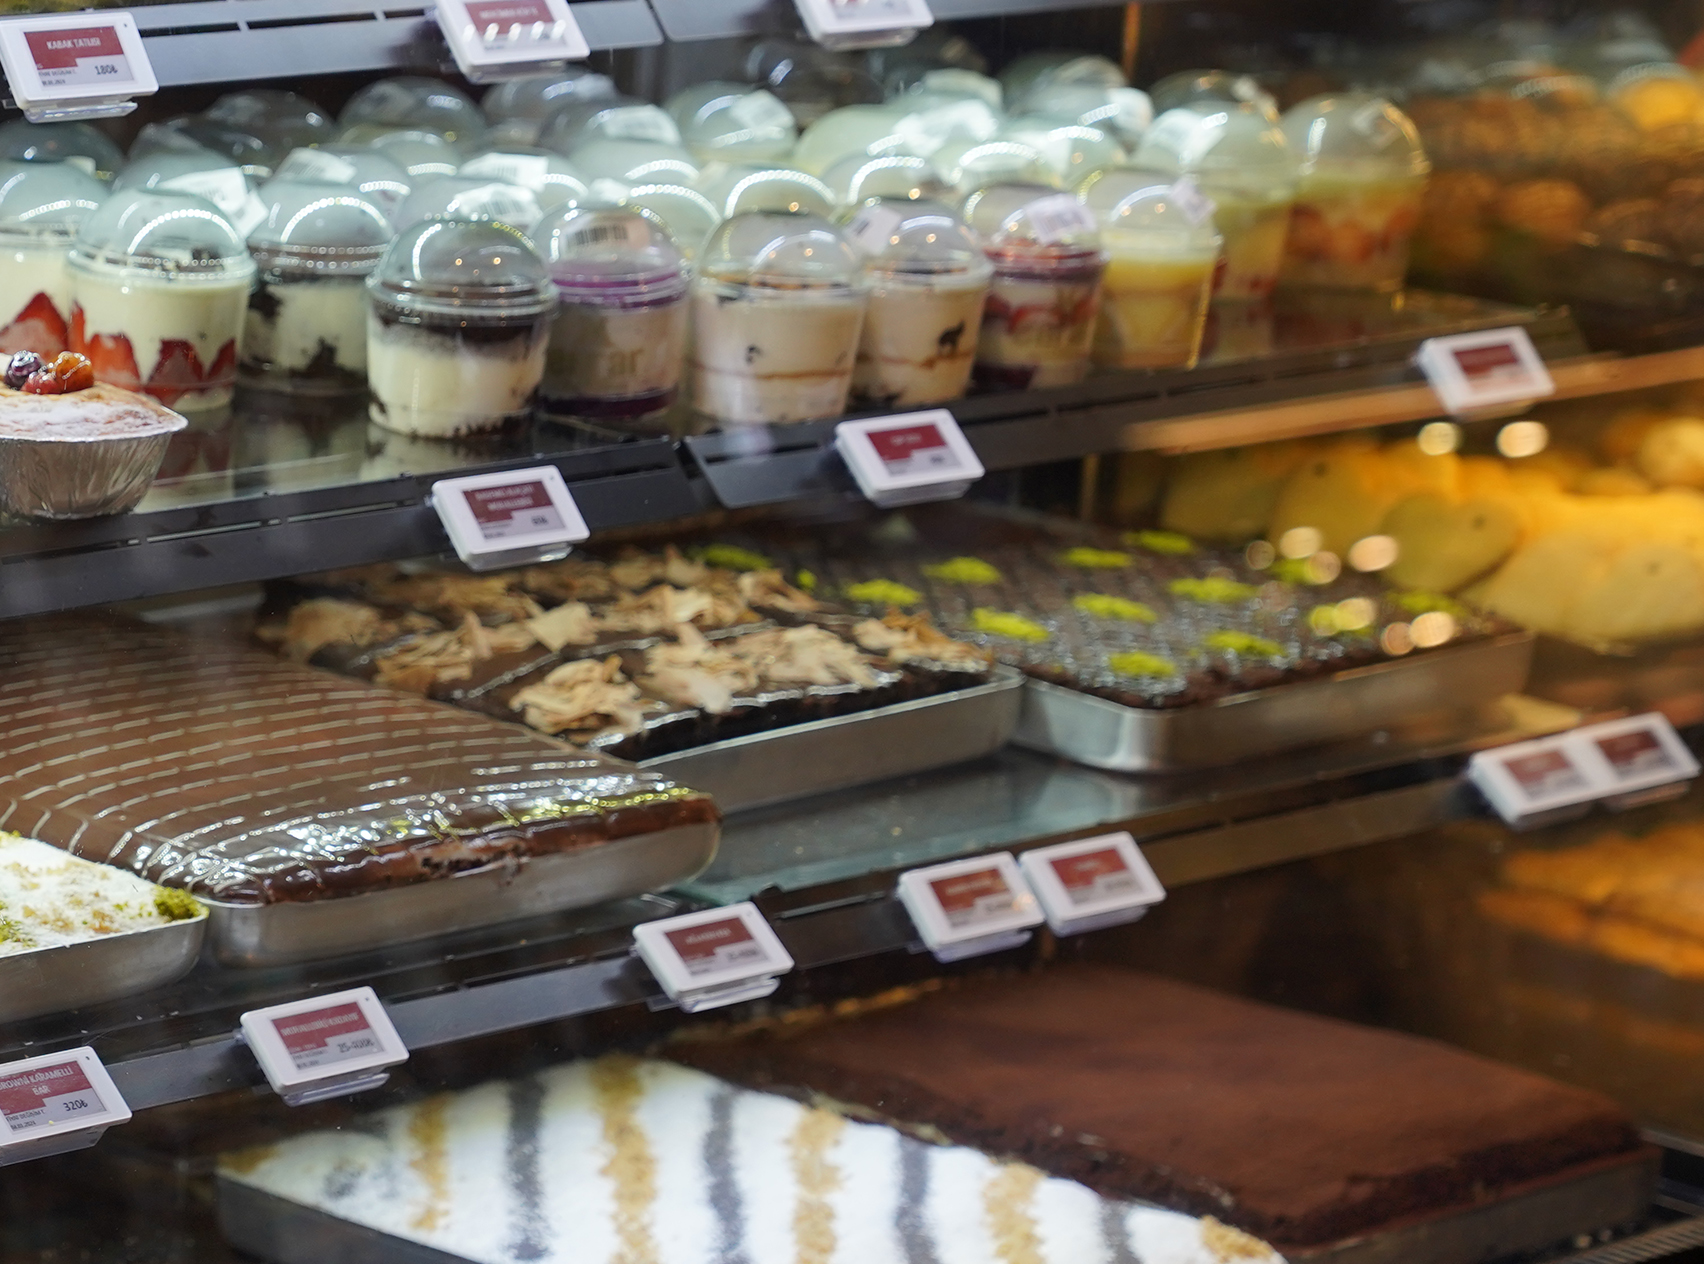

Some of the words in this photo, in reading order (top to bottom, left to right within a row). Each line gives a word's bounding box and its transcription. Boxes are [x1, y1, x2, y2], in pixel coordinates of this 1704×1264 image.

[29, 1066, 74, 1083] KARAMELLİ
[32, 1085, 51, 1096] BAR
[63, 1098, 88, 1112] 320₺
